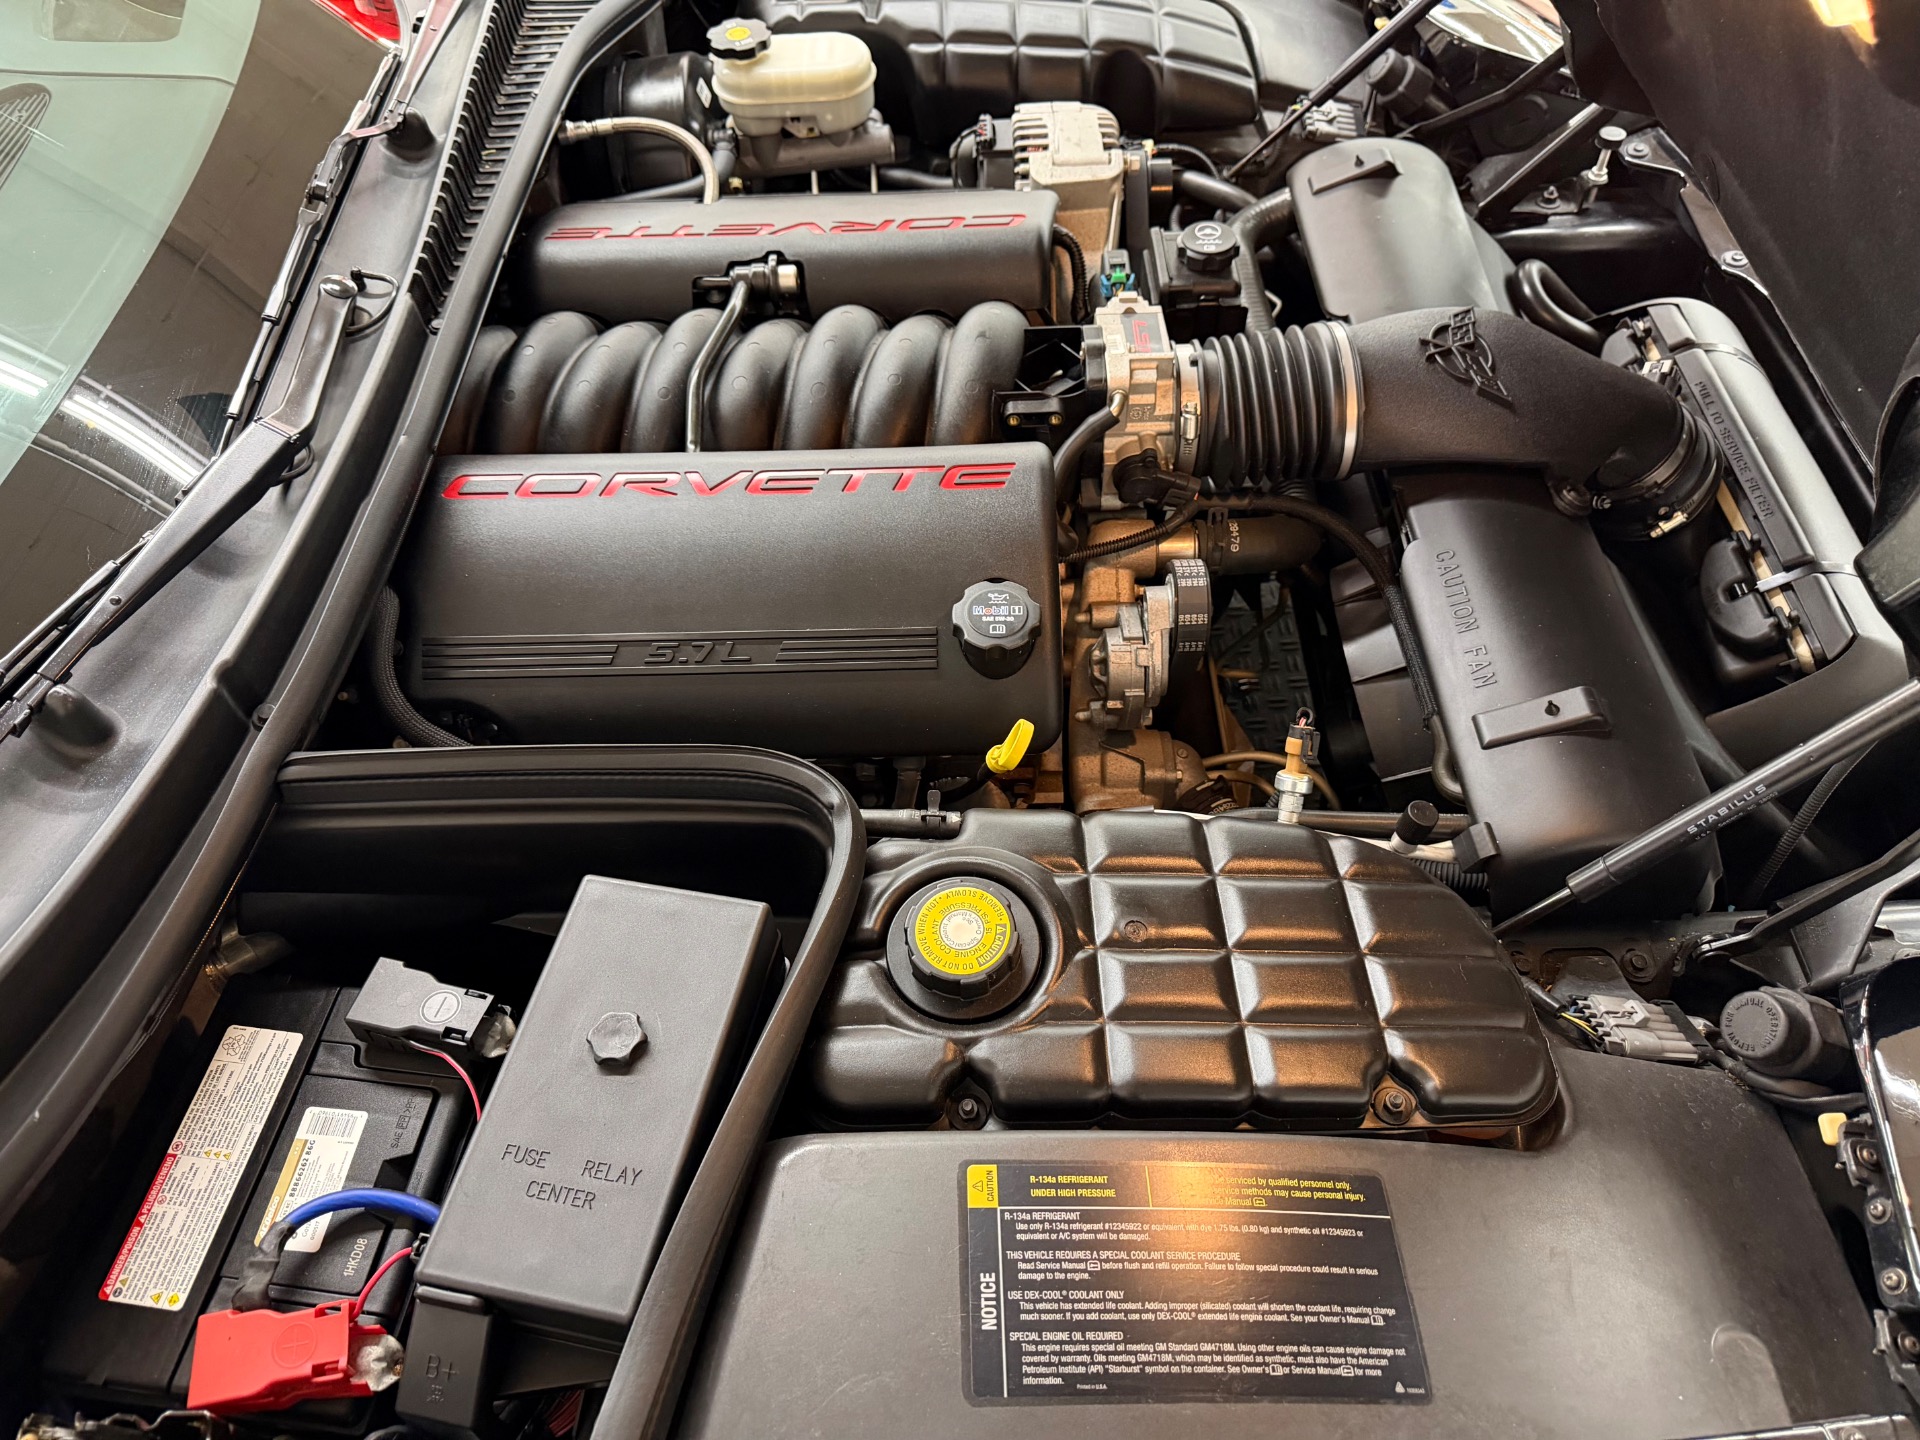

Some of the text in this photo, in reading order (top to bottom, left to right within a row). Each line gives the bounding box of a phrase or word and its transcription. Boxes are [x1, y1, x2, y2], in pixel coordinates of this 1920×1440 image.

[545, 214, 1026, 239] CORVETTE
[1694, 381, 1774, 518] PULL TO SERVICE FILTER
[442, 462, 1016, 499] CORVETTE
[972, 606, 1008, 615] Mobil
[1435, 549, 1498, 689] CAUTION FAN
[644, 641, 752, 664] 5.7L
[1686, 784, 1767, 834] STABILUS
[939, 902, 982, 916] PRESSURE
[946, 890, 1004, 918] REMOVE SLOWLY
[982, 912, 990, 924] PSI
[918, 898, 974, 970] DO NOT REMOVE WHEN HOT
[932, 919, 951, 954] COOLANT
[954, 943, 986, 957] ENGINE
[977, 934, 1004, 965] CAUTION
[1725, 1012, 1734, 1028] FOR
[390, 1132, 403, 1148] SAE
[289, 1139, 316, 1198] 88866262 86G
[501, 1144, 643, 1186] FUSE RELAY
[1029, 1175, 1108, 1184] R-134a REFRIGERANT
[1226, 1176, 1351, 1191] serviced by qualified personnel only.
[526, 1180, 596, 1210] CENTER
[1030, 1188, 1116, 1198] UNDER HIGH PRESSURE
[1241, 1187, 1272, 1196] methods
[1273, 1190, 1288, 1198] may
[1312, 1189, 1343, 1200] personal
[1344, 1191, 1365, 1202] injury.
[108, 1156, 174, 1286] DANGER/POISON PELIGRO/VENENO
[1004, 1212, 1080, 1220] R-134a REFRIGERANT
[1015, 1222, 1028, 1231] Use
[1029, 1222, 1043, 1232] only
[1044, 1222, 1068, 1230] R-134a
[1069, 1222, 1103, 1232] refrigerant
[1104, 1222, 1141, 1231] #12345922
[1258, 1225, 1269, 1235] kg)
[1270, 1225, 1282, 1234] and
[1283, 1226, 1311, 1236] synthetic
[1312, 1226, 1320, 1236] oil
[1015, 1232, 1049, 1242] equivalent
[1058, 1232, 1070, 1241] A/C
[1071, 1232, 1095, 1242] system
[1096, 1232, 1107, 1241] will
[1108, 1232, 1117, 1241] be
[1118, 1232, 1150, 1242] damaged.
[343, 1238, 368, 1276] 1HKD08
[1006, 1250, 1240, 1261] THIS VEHICLE REQUIRES A SPECIAL COOLANT SERVICE PROCEDURE
[1017, 1271, 1090, 1281] damage to the engine.
[980, 1272, 997, 1331] NOTICE
[1007, 1290, 1022, 1299] USE
[1068, 1290, 1102, 1299] COOLANT
[1105, 1290, 1124, 1299] ONLY
[1019, 1311, 1039, 1320] much
[1065, 1311, 1070, 1320] If
[1085, 1311, 1098, 1320] add
[1099, 1311, 1126, 1320] coolant,
[1141, 1311, 1155, 1321] only
[1197, 1312, 1227, 1321] extended
[1228, 1312, 1239, 1321] life
[1240, 1312, 1262, 1323] engine
[1263, 1313, 1289, 1322] coolant.
[1290, 1314, 1302, 1322] See
[1303, 1316, 1318, 1324] your
[1319, 1314, 1346, 1324] Owner's
[1346, 1315, 1370, 1324] Manual
[1009, 1332, 1123, 1340] SPECIAL ENGINE OIL REQUIRED
[1021, 1343, 1036, 1352] This
[1037, 1343, 1060, 1352] engine
[1061, 1342, 1090, 1352] requires
[1090, 1342, 1115, 1352] special
[1116, 1342, 1124, 1351] oil
[1126, 1343, 1153, 1352] meeting
[1154, 1343, 1166, 1351] GM
[1168, 1343, 1198, 1352] Standard
[1199, 1343, 1236, 1352] GM4718M.
[1237, 1343, 1256, 1353] Using
[1257, 1344, 1274, 1352] other
[1275, 1344, 1298, 1354] engine
[1298, 1344, 1311, 1353] oils
[1345, 1345, 1367, 1356] engine
[1368, 1346, 1394, 1357] damage
[1394, 1347, 1406, 1356] not
[426, 1353, 460, 1382] B+
[1022, 1376, 1064, 1385] information.
